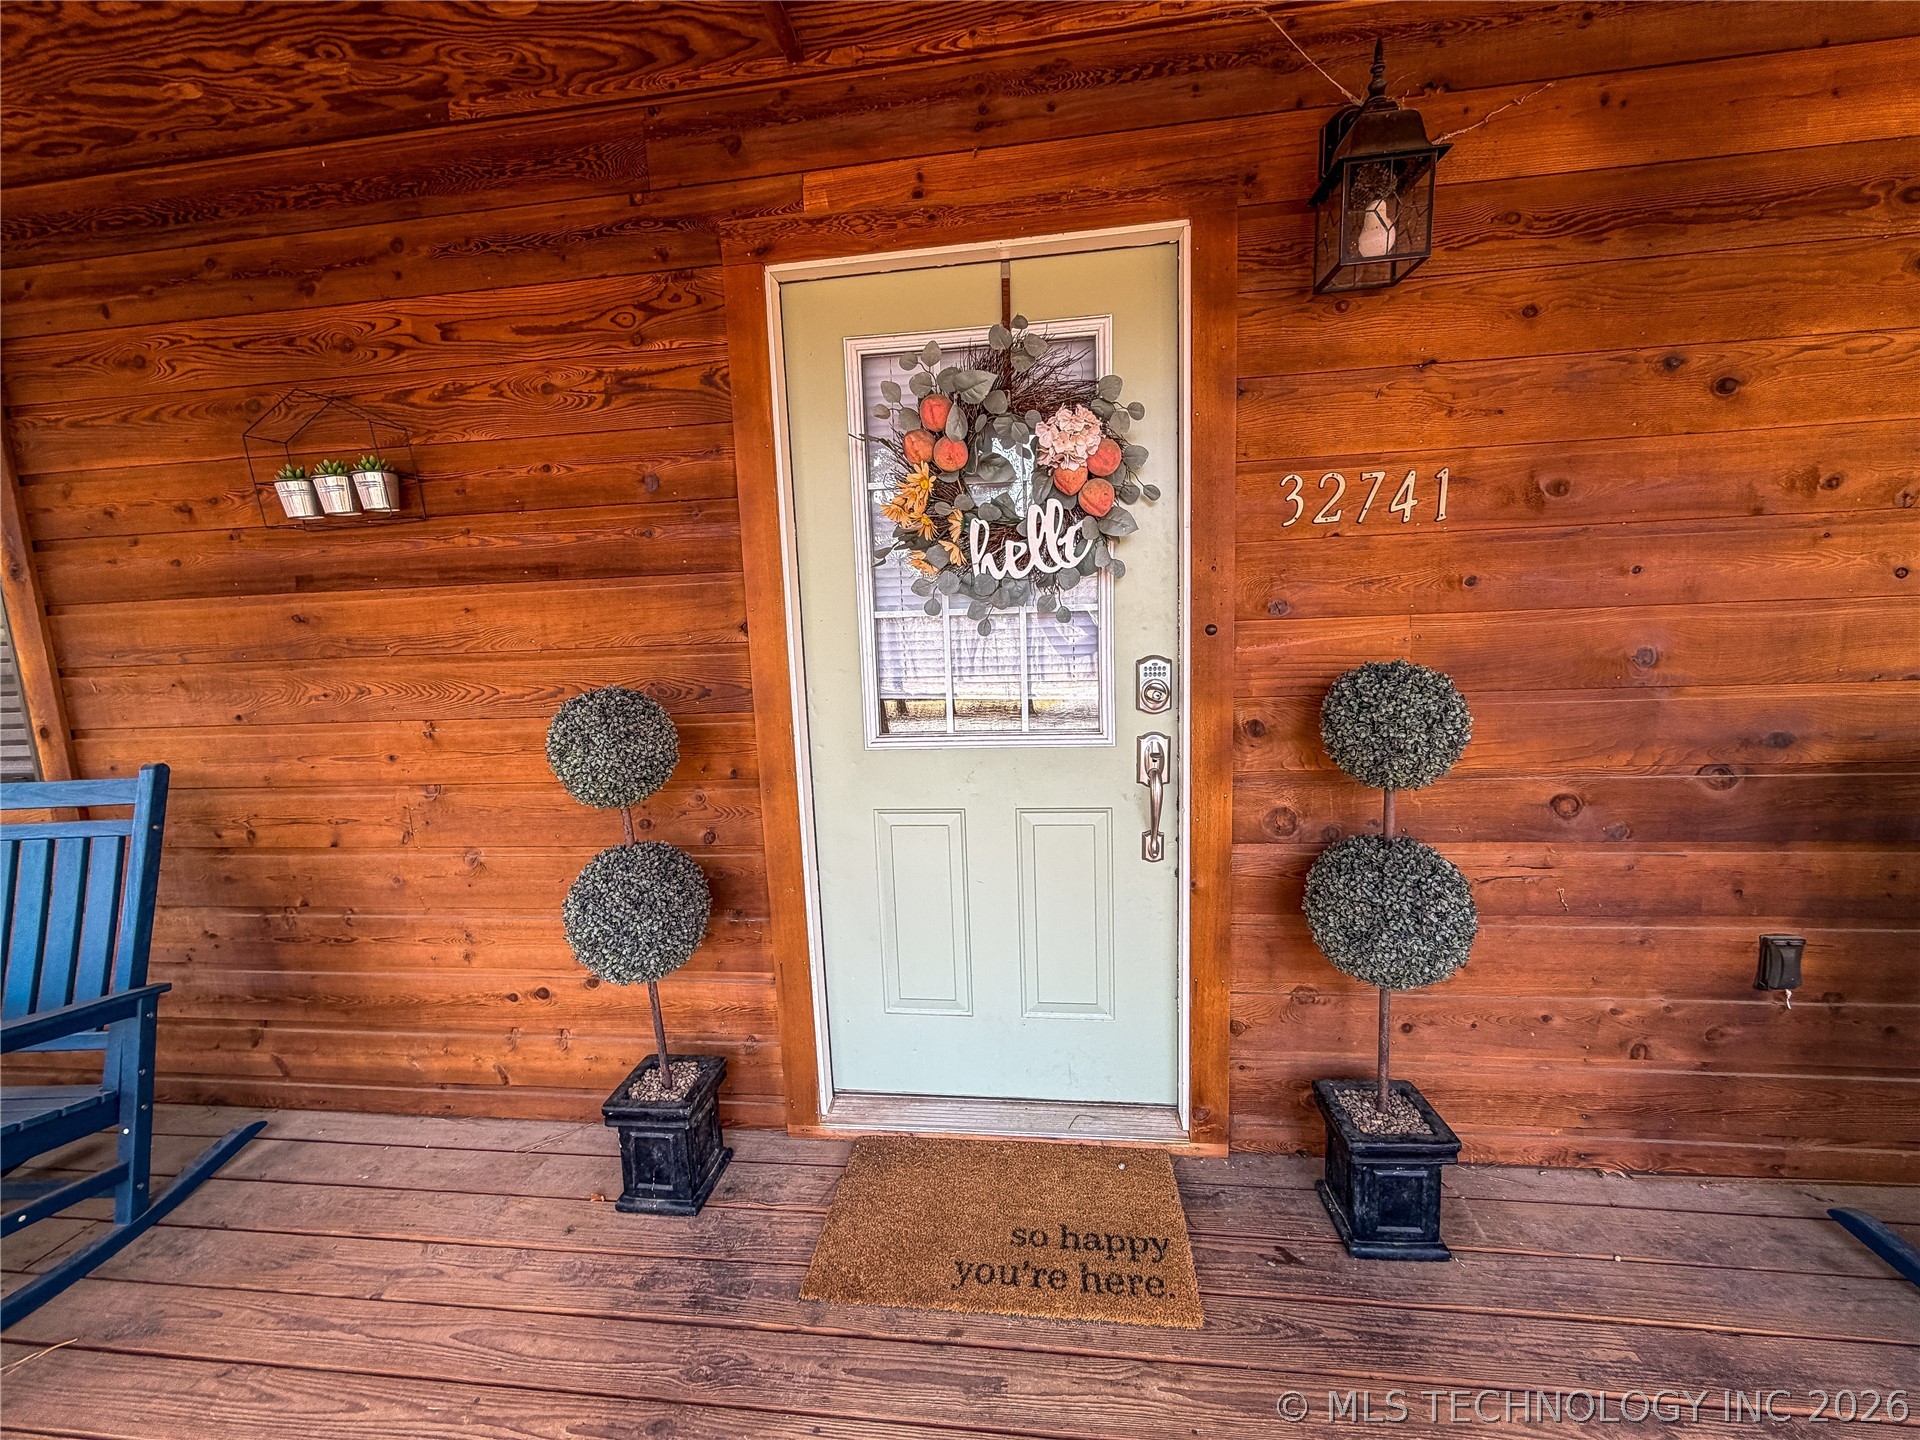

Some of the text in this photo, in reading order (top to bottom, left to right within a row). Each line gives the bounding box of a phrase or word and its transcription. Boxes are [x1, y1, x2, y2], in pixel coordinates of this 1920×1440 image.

[1279, 467, 1450, 527] 32741
[969, 498, 1093, 580] hello
[1010, 1224, 1169, 1264] so happy
[950, 1259, 1176, 1300] you're here.
